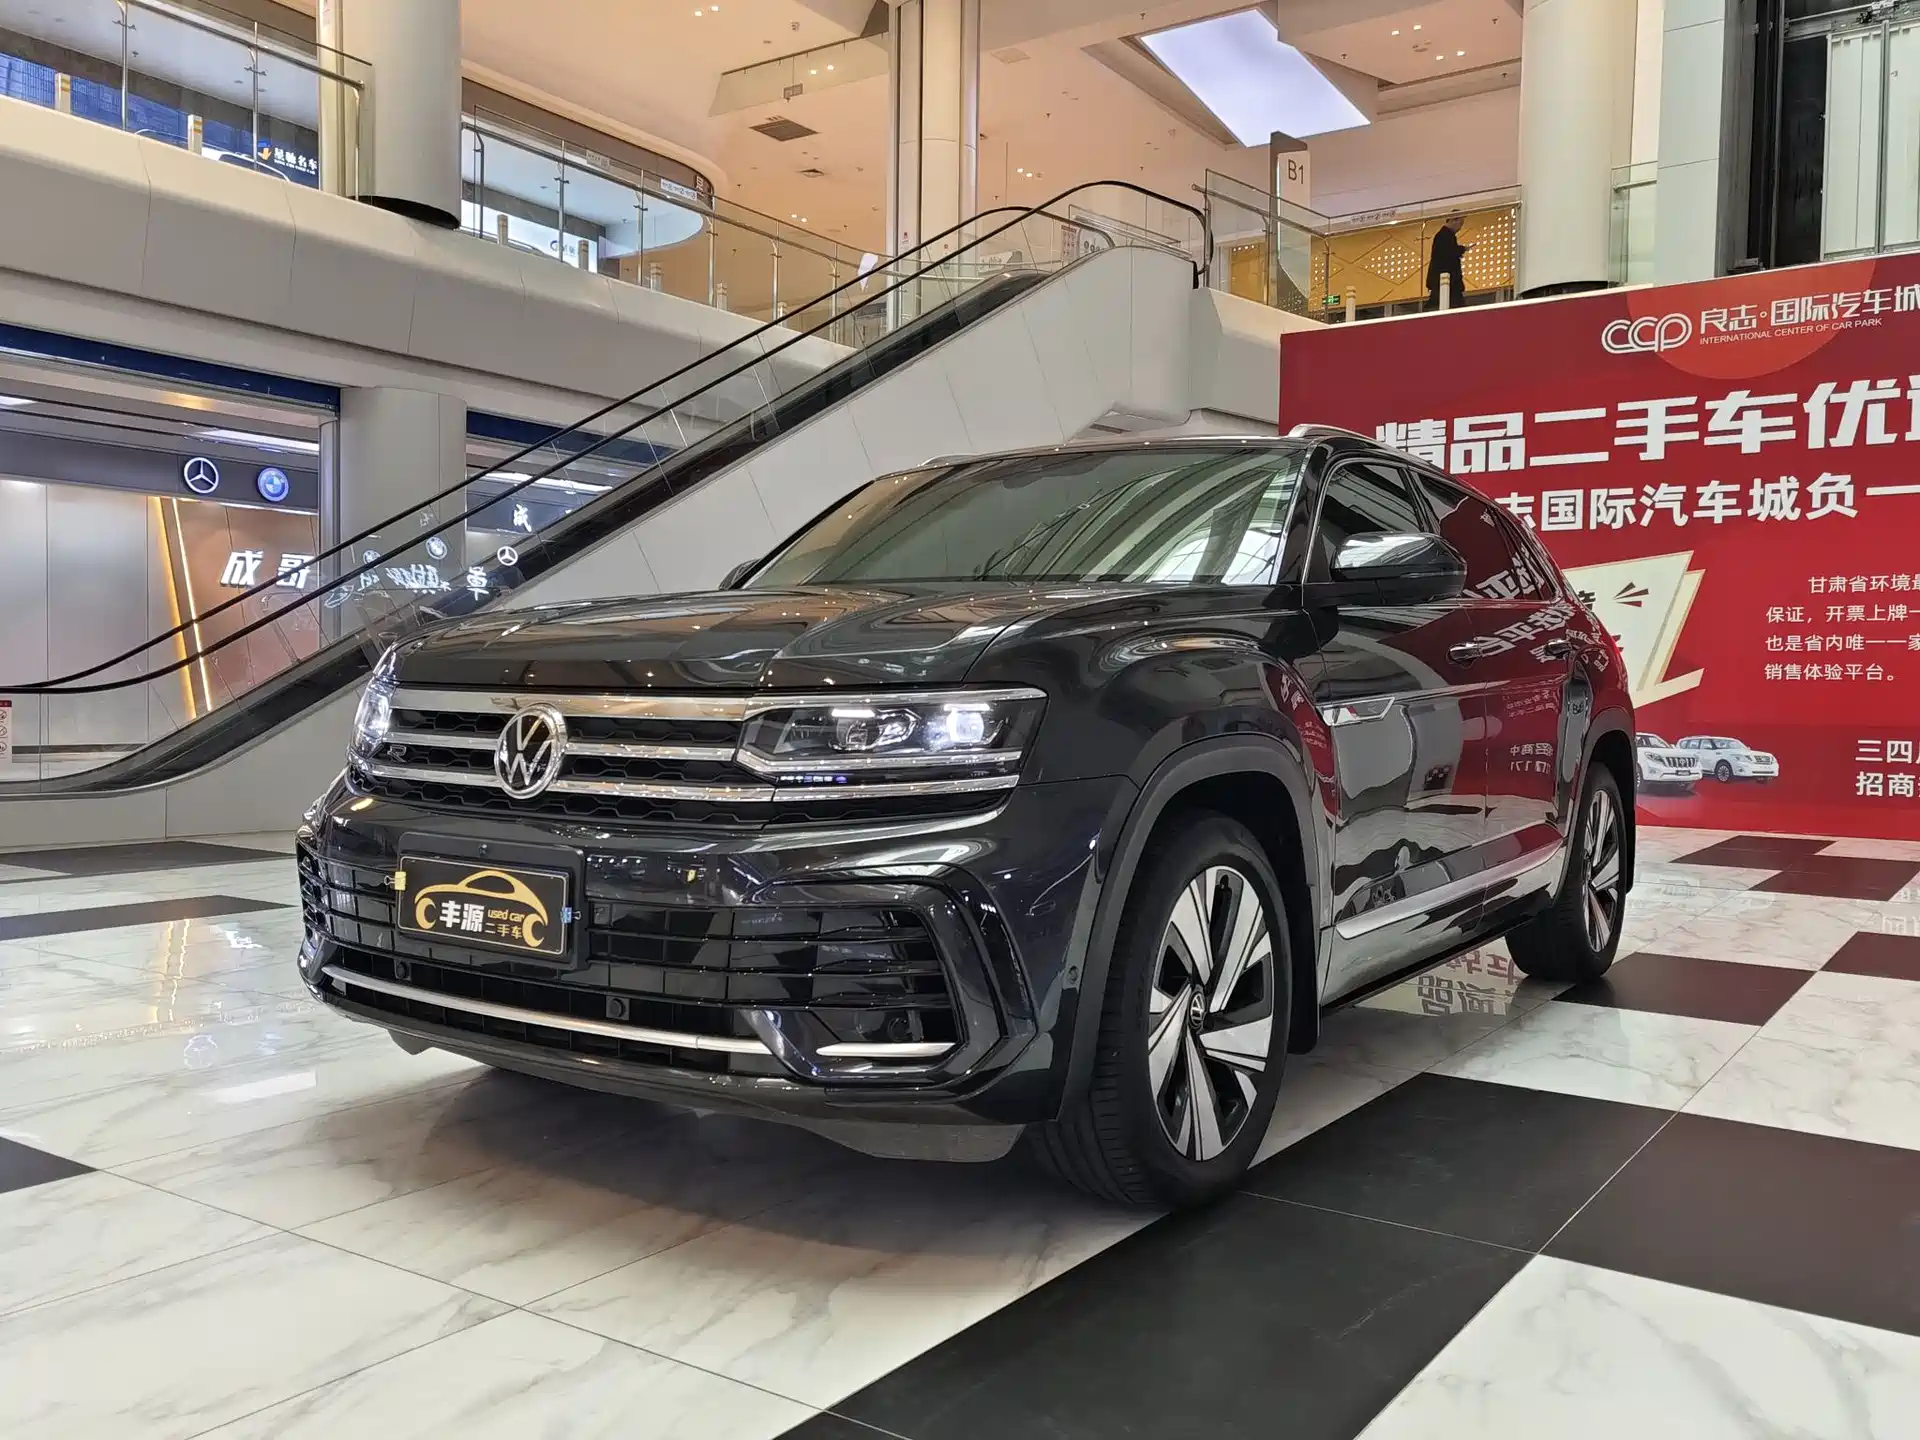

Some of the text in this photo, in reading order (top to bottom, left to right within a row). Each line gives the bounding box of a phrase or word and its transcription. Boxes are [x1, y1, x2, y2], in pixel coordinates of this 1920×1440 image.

[1288, 159, 1304, 184] B1
[1700, 317, 1882, 345] INTERNATIONAL CENTER OF CAR PARK
[1376, 374, 1920, 475] 精品二手车优
[1764, 663, 1895, 682] 销售体验平台。
[1855, 739, 1920, 764] 三四
[1855, 771, 1920, 798] 招商
[439, 900, 485, 932] 丰源
[487, 908, 525, 922] used car
[484, 922, 523, 939] 二手车
